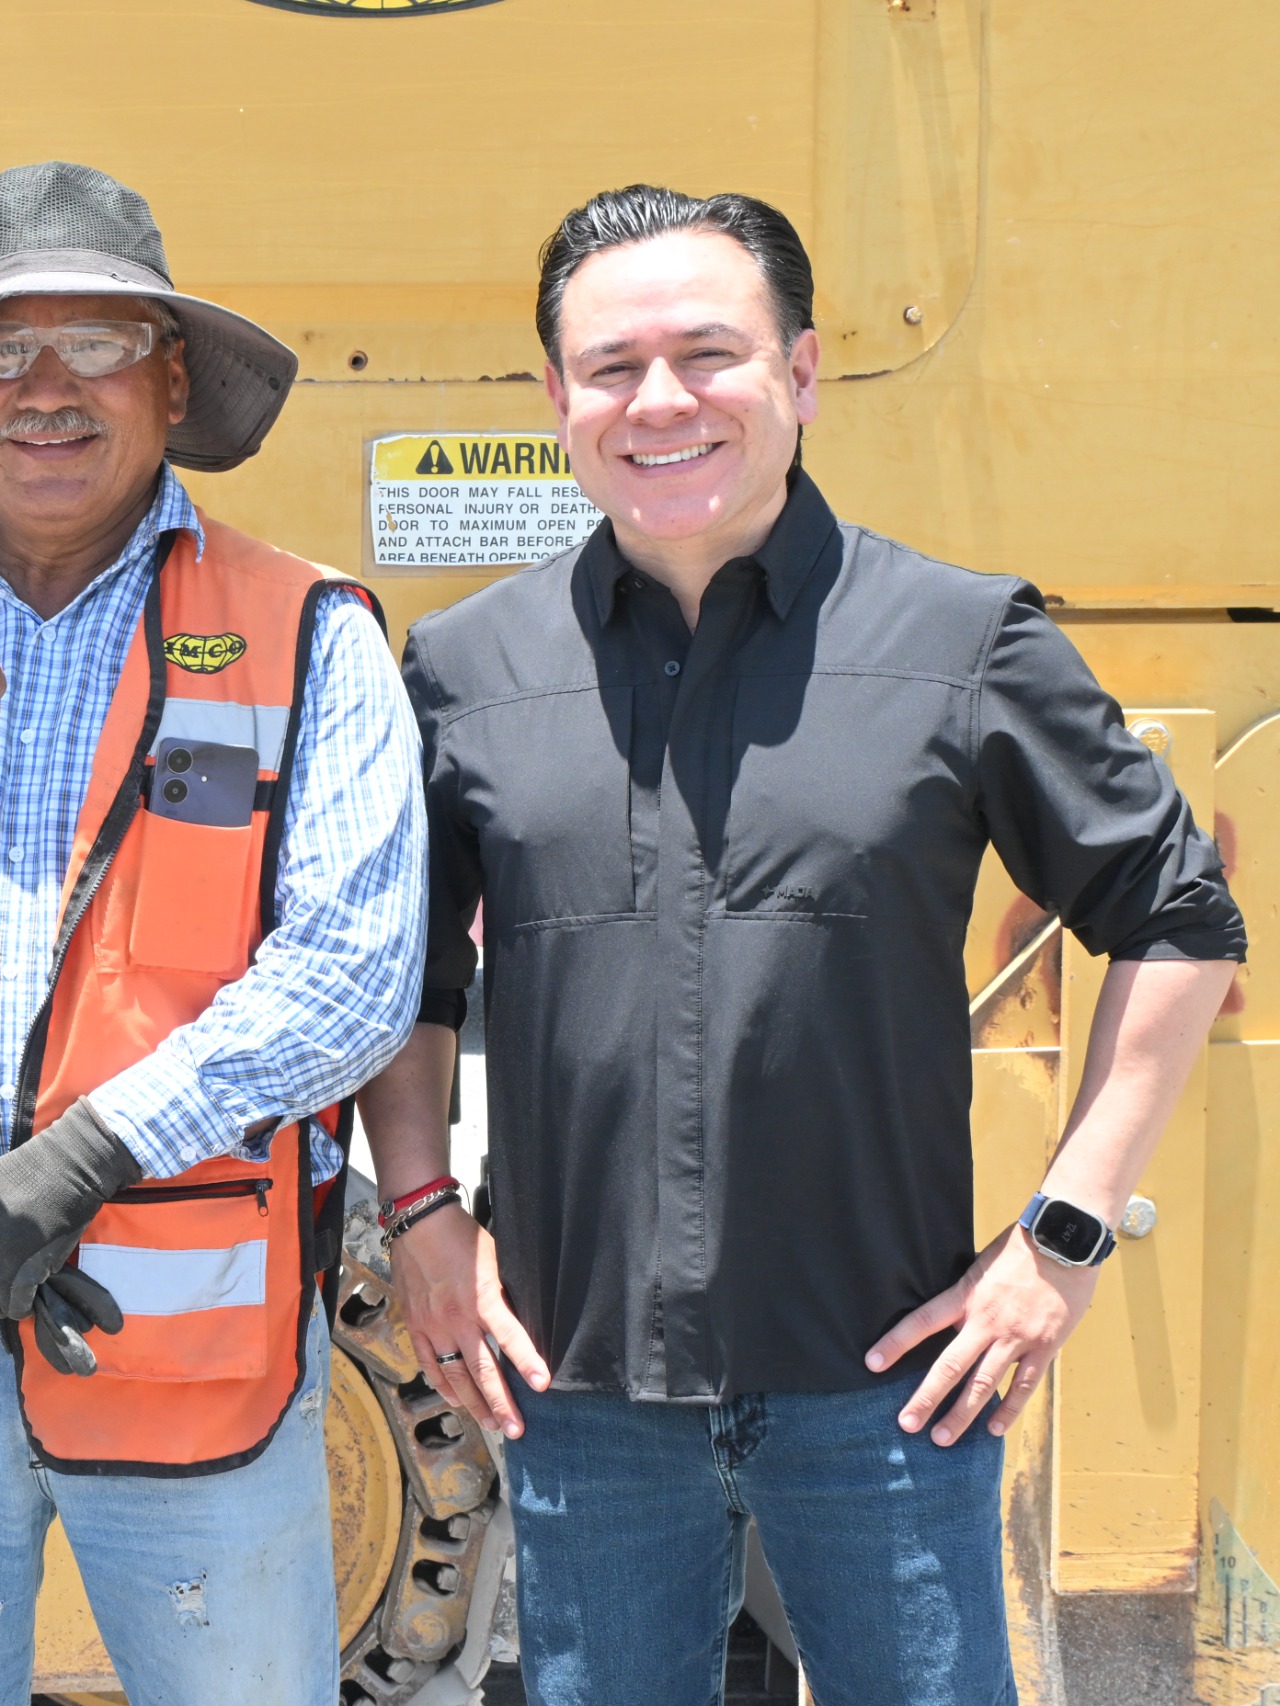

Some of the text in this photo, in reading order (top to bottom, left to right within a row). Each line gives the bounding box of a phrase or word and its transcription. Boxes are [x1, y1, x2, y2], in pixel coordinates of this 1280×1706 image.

[378, 487, 410, 498] THIS
[419, 487, 459, 497] DOOR
[469, 487, 498, 497] MAY
[508, 487, 542, 497] FALL
[379, 503, 600, 515] PERSONAL INJURY OR DEATH.
[430, 520, 448, 530] TO
[460, 520, 526, 530] MAXIMUM
[538, 520, 575, 530] OPEN
[378, 537, 407, 547] AND
[416, 537, 471, 547] ATTACH
[480, 537, 508, 546] BAR
[517, 536, 573, 546] BEFORE
[378, 551, 550, 563] AREA BENEATH OPEN DO
